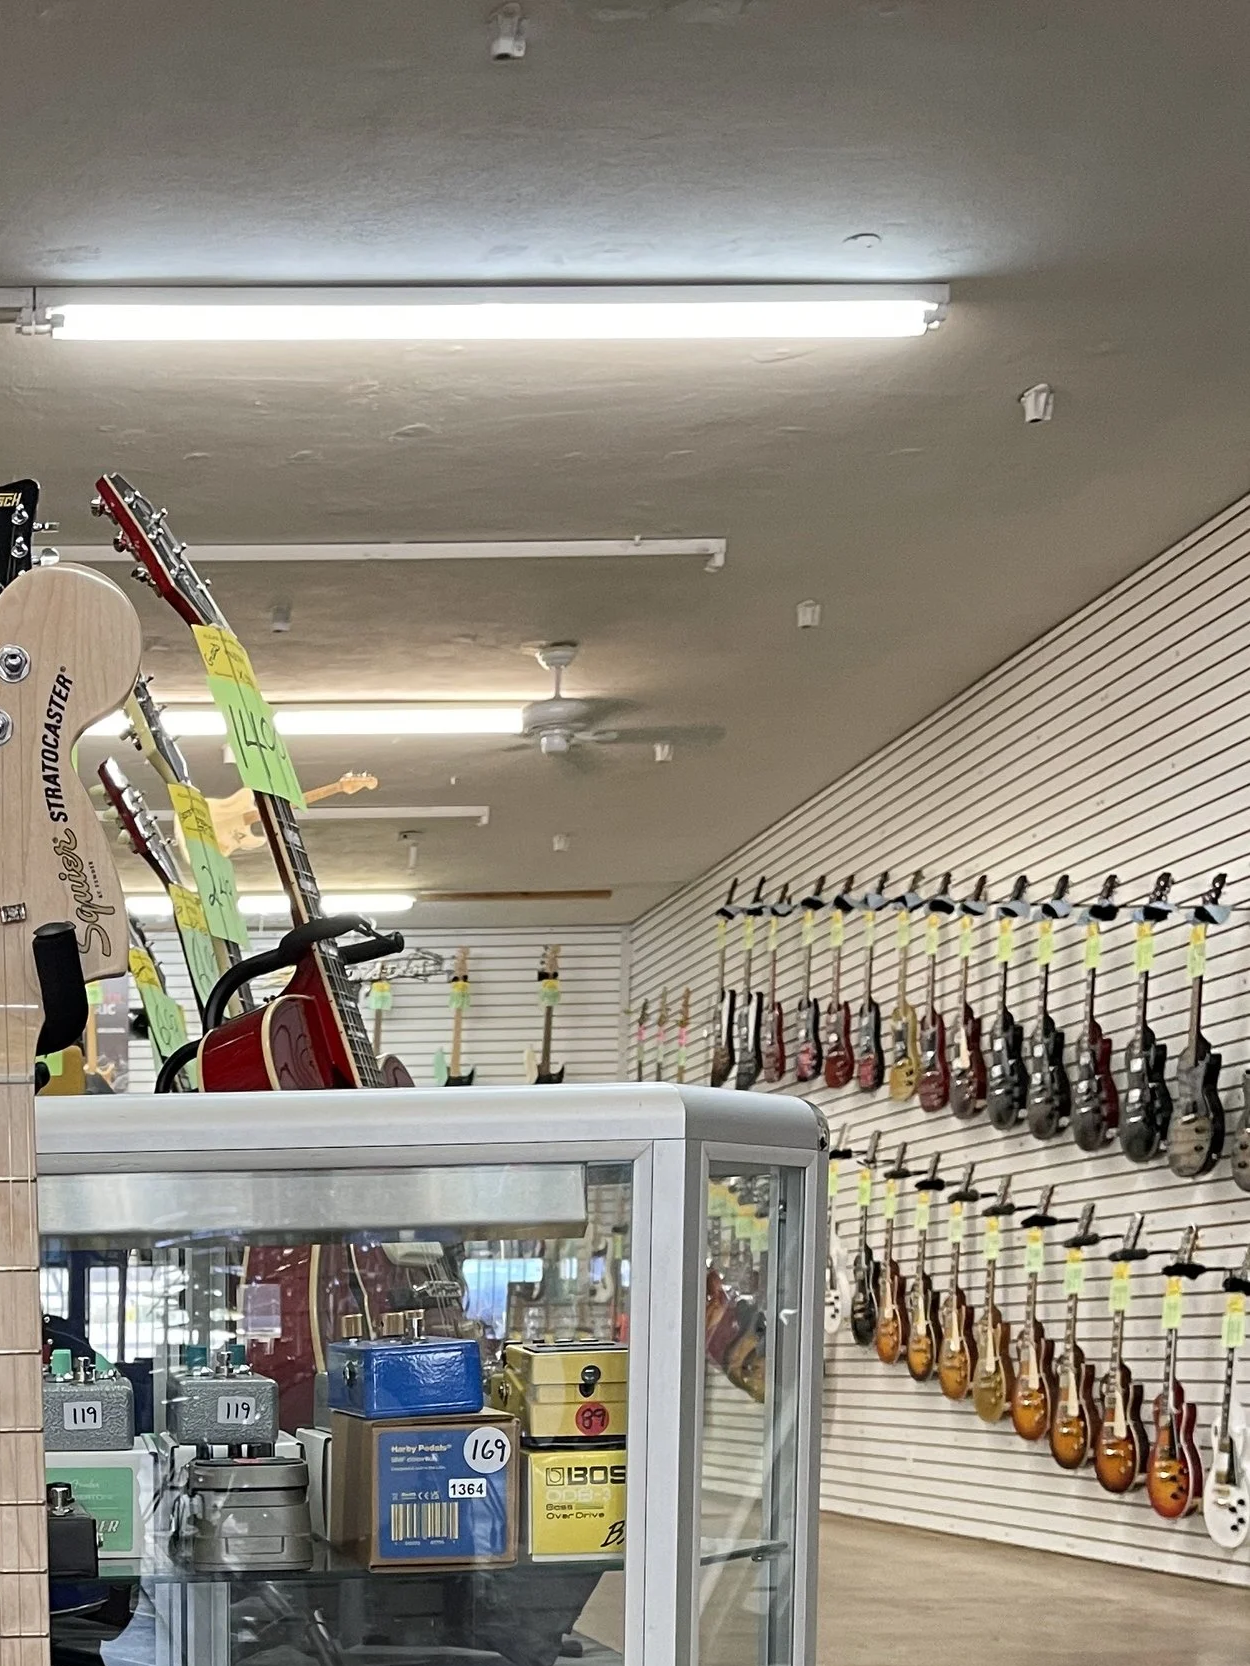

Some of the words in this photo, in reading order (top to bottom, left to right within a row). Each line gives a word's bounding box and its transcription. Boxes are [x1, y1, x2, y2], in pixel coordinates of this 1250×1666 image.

[53, 828, 116, 957] Squier
[71, 1406, 97, 1425] 119
[225, 1402, 251, 1421] 119
[581, 1408, 606, 1430] 89
[471, 1438, 507, 1463] 169
[567, 1465, 626, 1485] BOS
[450, 1483, 484, 1496] 1364
